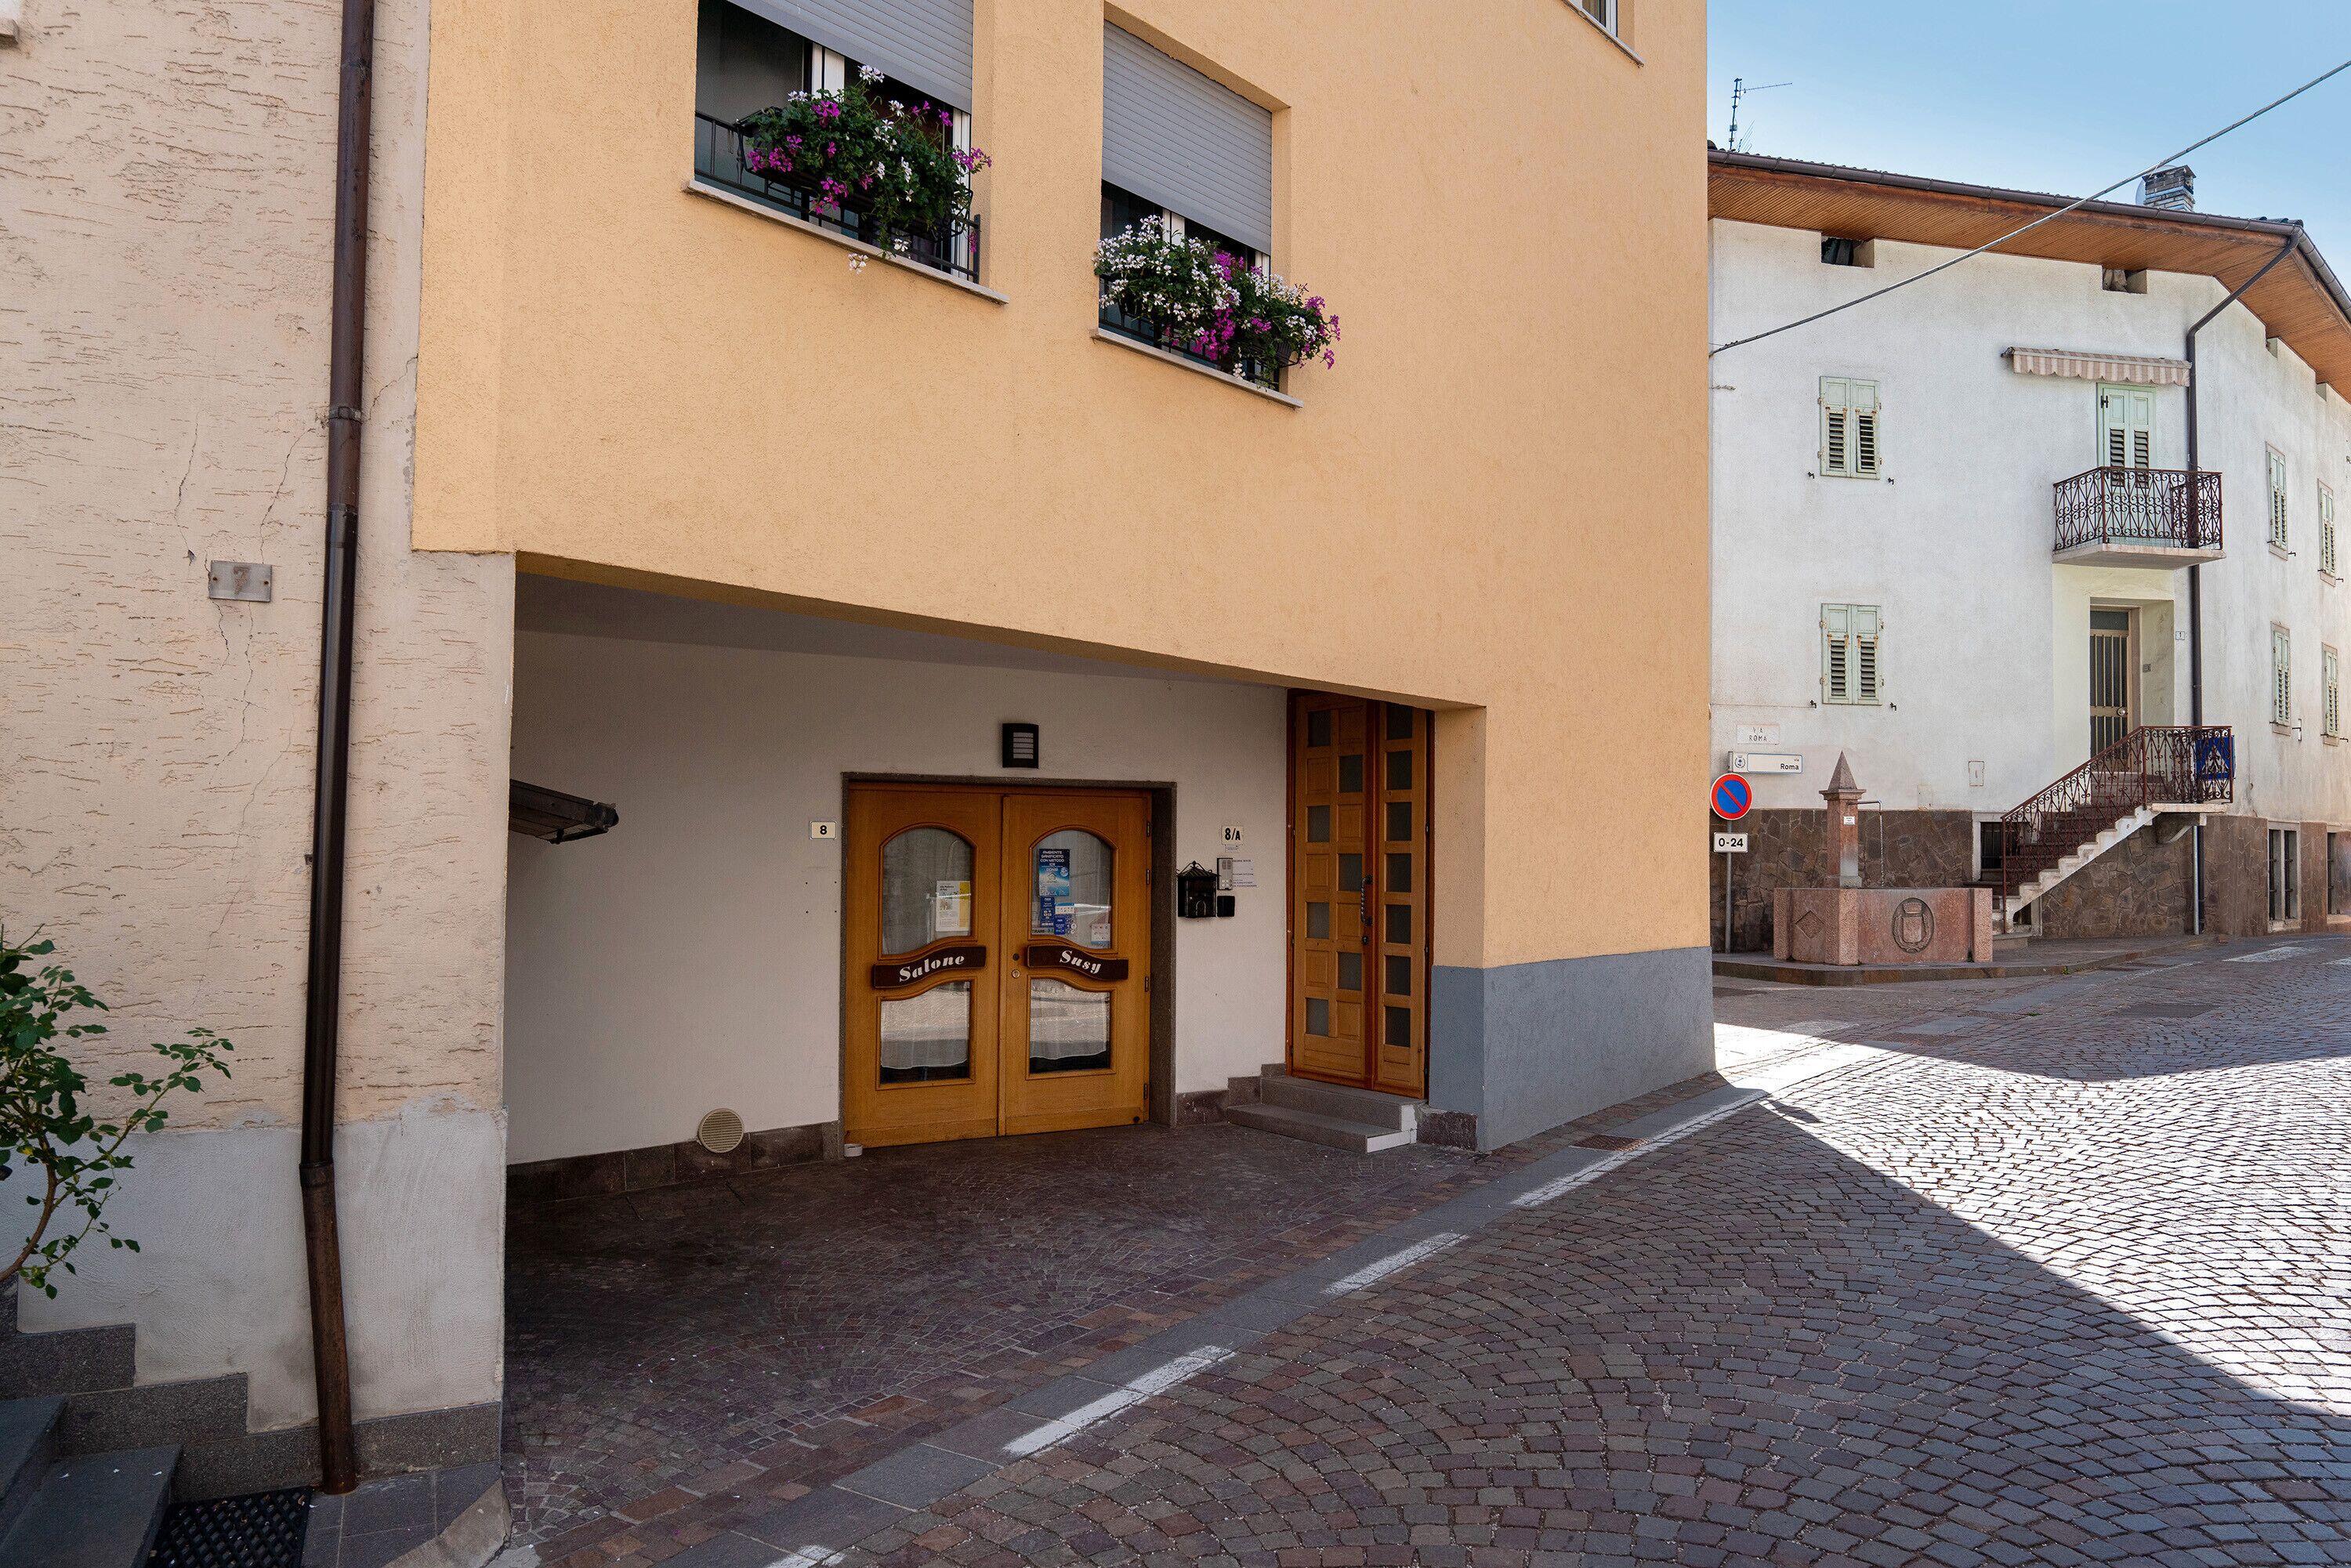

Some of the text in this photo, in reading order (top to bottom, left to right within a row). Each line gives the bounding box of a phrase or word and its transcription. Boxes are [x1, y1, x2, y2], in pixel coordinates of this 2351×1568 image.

[232, 565, 251, 594] 7
[820, 824, 828, 835] 8
[1225, 827, 1241, 841] 8/A
[899, 950, 1101, 983] Salone Susy
